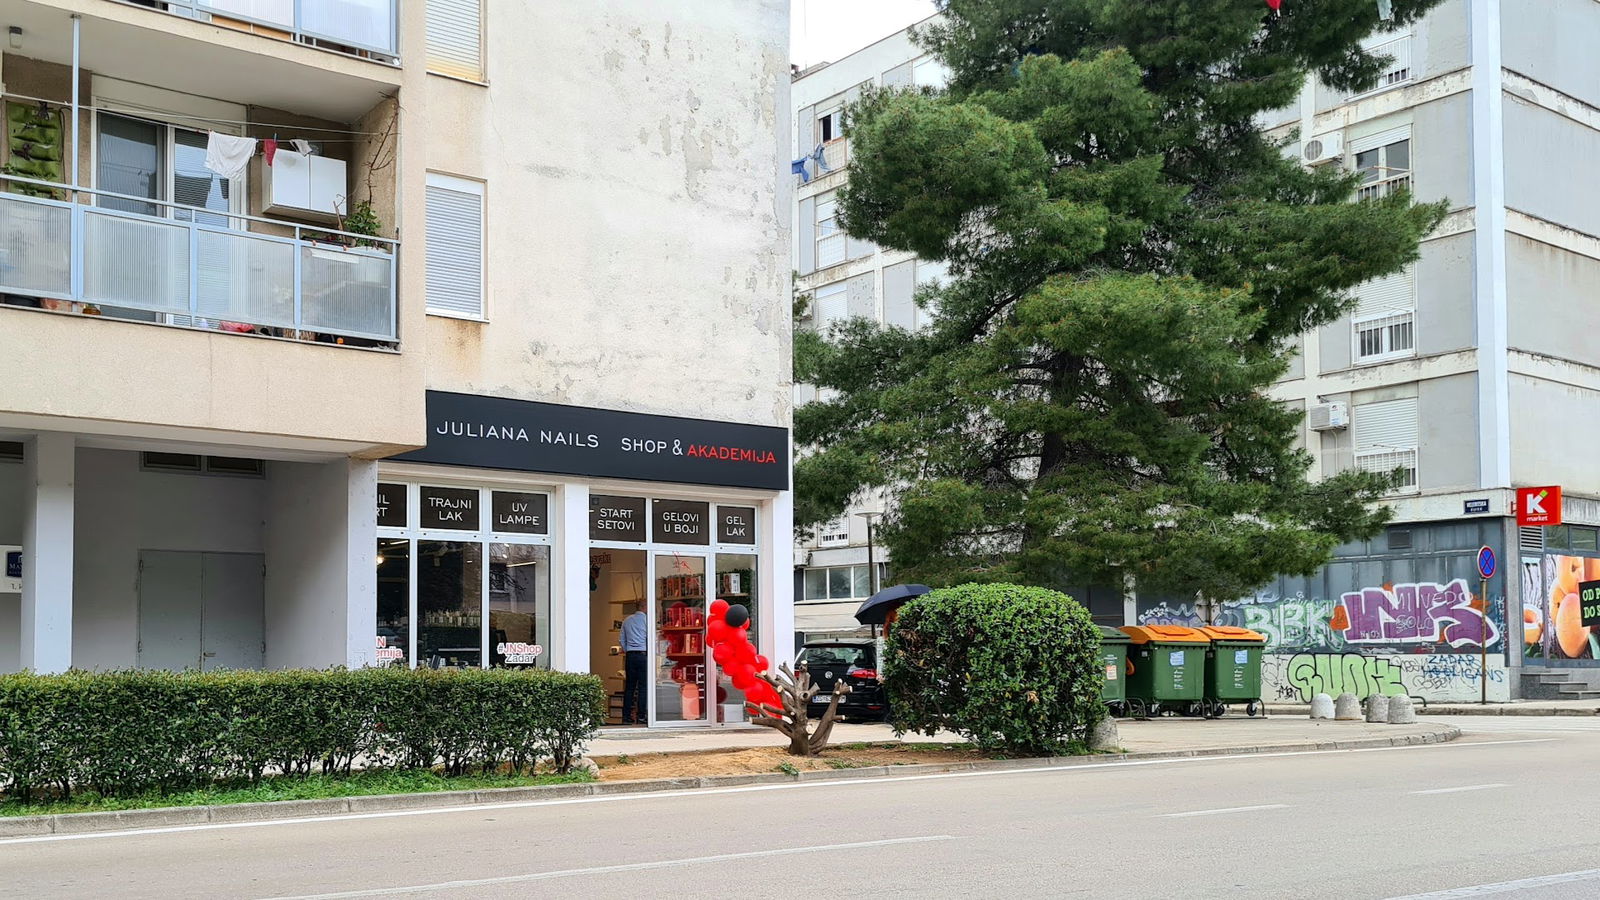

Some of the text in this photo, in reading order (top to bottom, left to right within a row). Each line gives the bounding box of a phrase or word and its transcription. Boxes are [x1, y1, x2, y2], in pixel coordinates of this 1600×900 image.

[436, 420, 599, 448] JULIANA NAILS
[621, 437, 776, 464] SHOP & AKADEMIJA
[428, 497, 472, 509] TRAJNI
[512, 503, 528, 512] UV
[438, 511, 463, 521] LAK
[600, 508, 634, 519] START
[662, 512, 699, 523] GELOVI
[500, 514, 540, 526] LAMPE
[597, 520, 635, 531] SETOVI
[726, 516, 746, 526] GEL
[664, 525, 699, 534] U BOJI
[726, 527, 746, 537] LAK
[1582, 588, 1595, 601] OD
[1583, 605, 1596, 618] DO
[497, 643, 542, 655] #JNShop
[505, 654, 534, 663] Zadar
[1428, 654, 1477, 667] ZADAR
